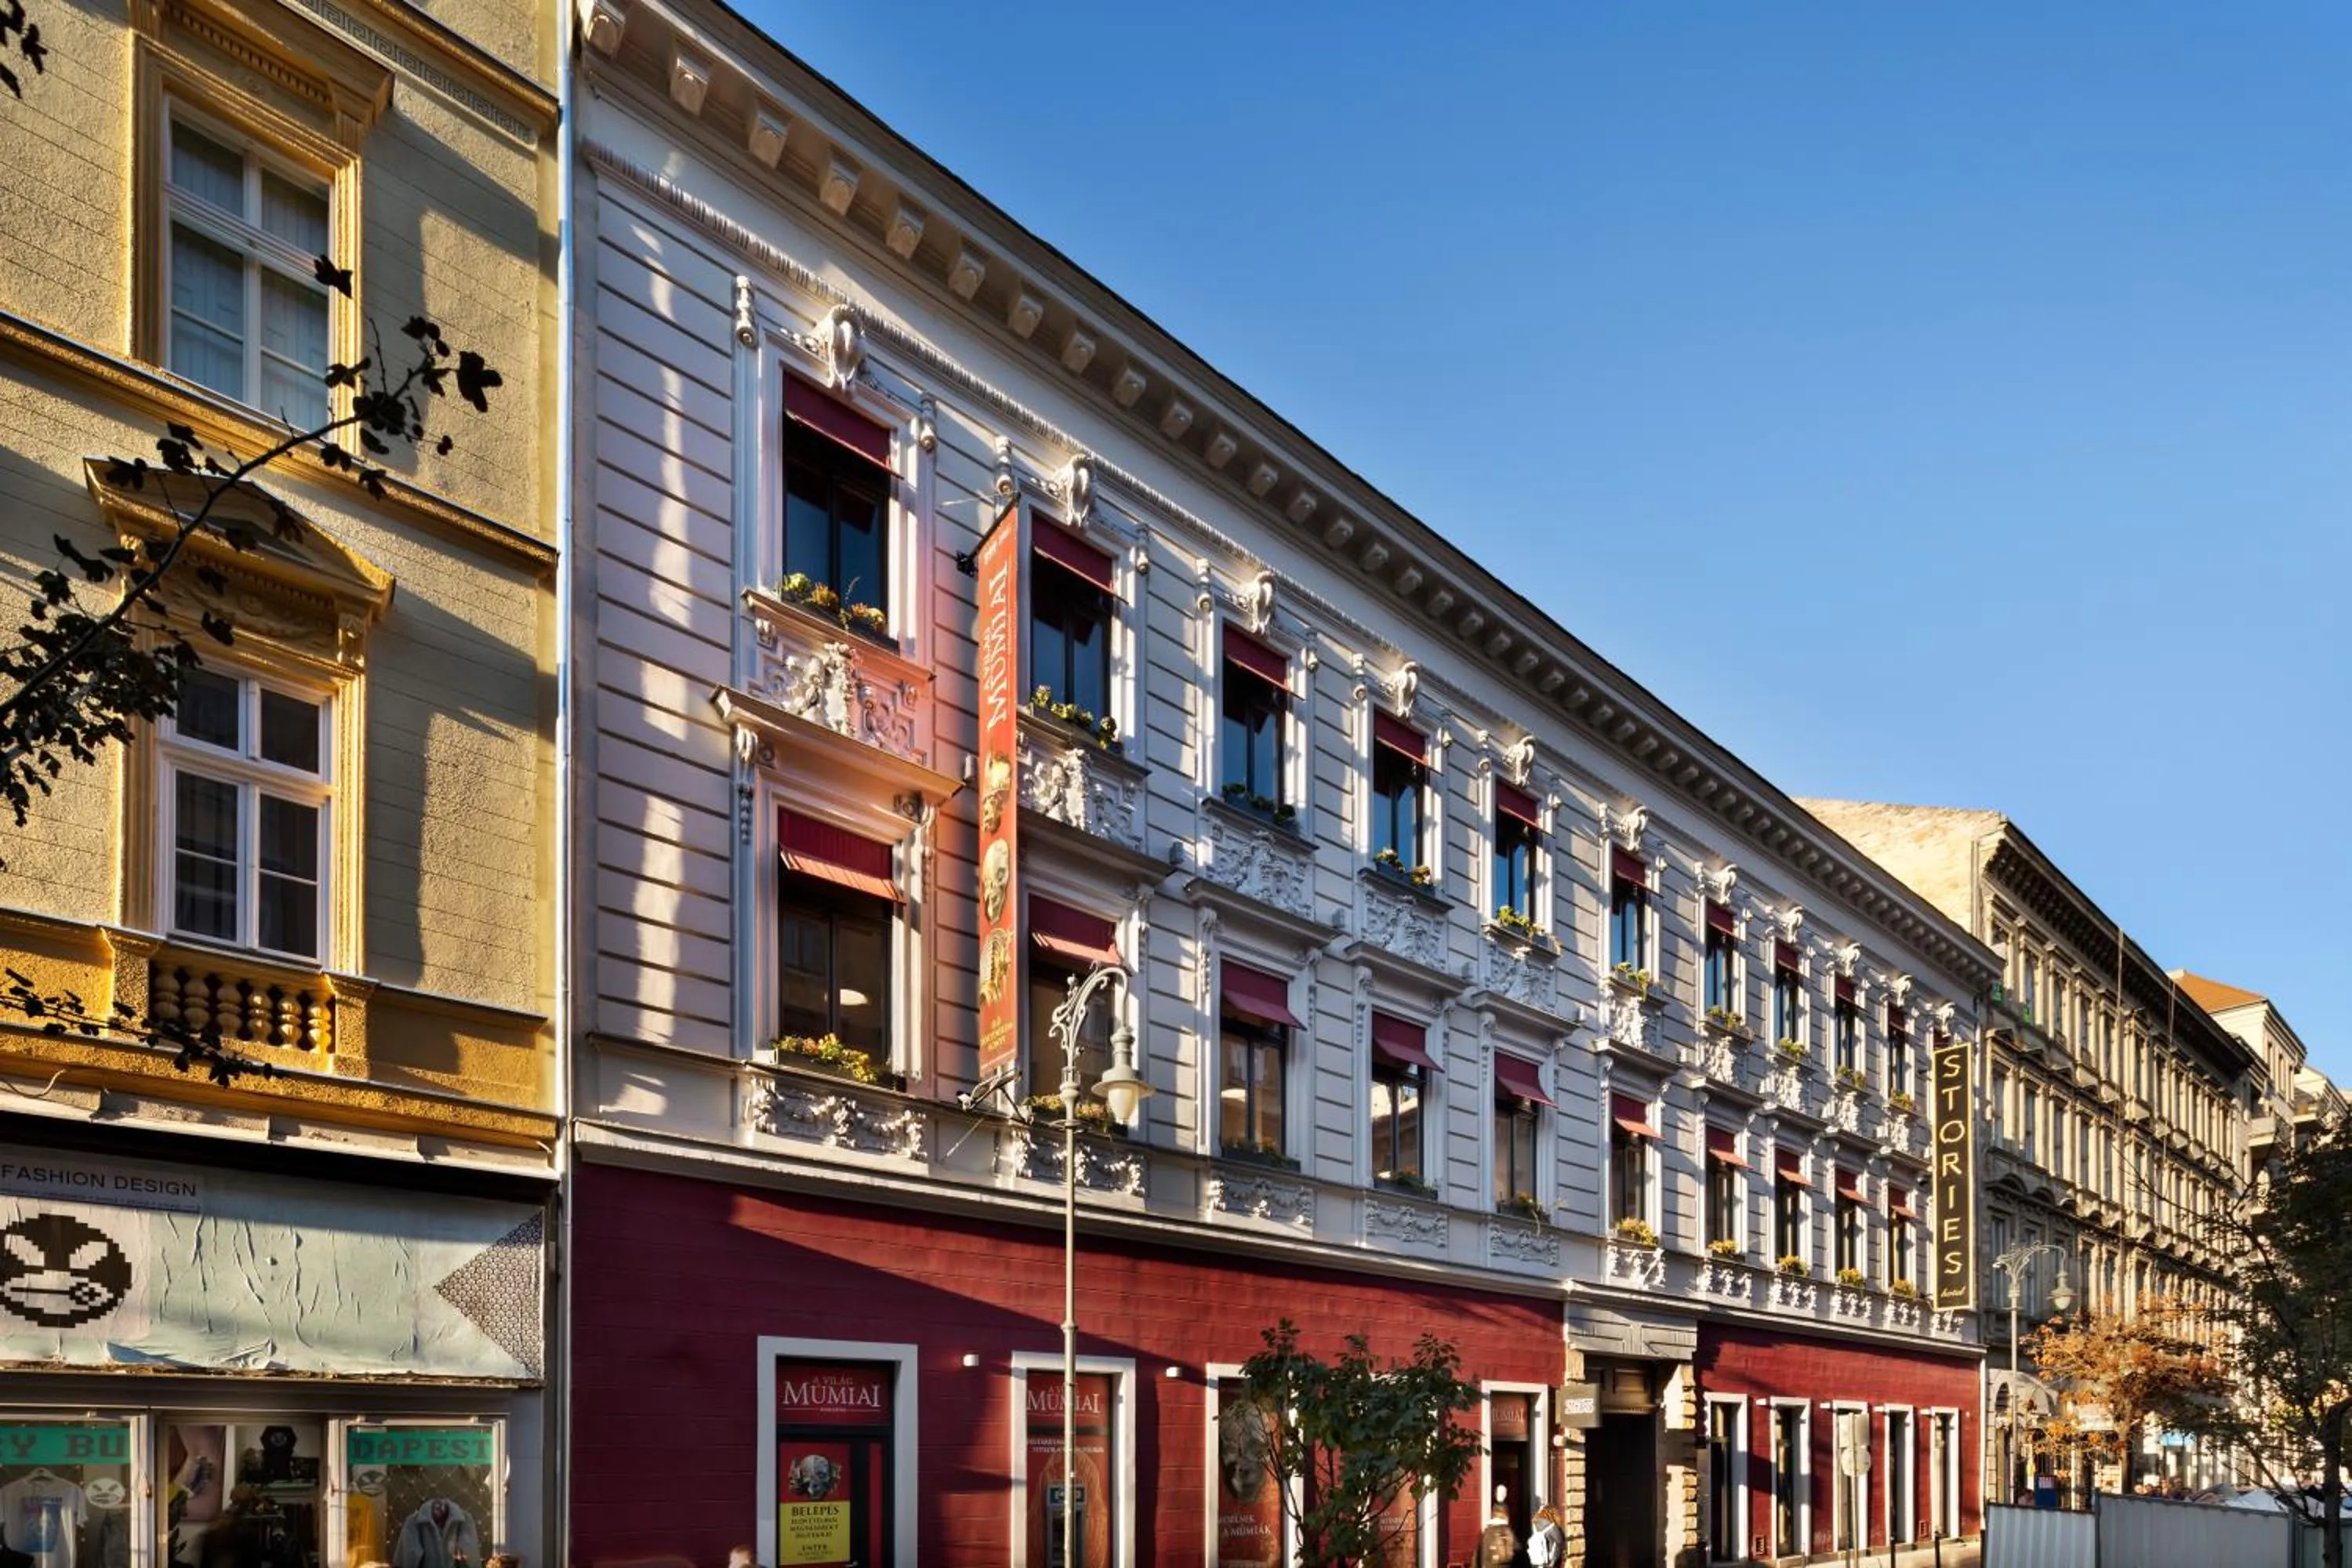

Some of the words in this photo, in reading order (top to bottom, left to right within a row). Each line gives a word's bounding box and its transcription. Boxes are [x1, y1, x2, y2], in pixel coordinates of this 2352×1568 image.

[2, 1164, 105, 1189] FASHION
[114, 1175, 197, 1197] DESIGN
[1940, 1054, 1966, 1276] STORIES
